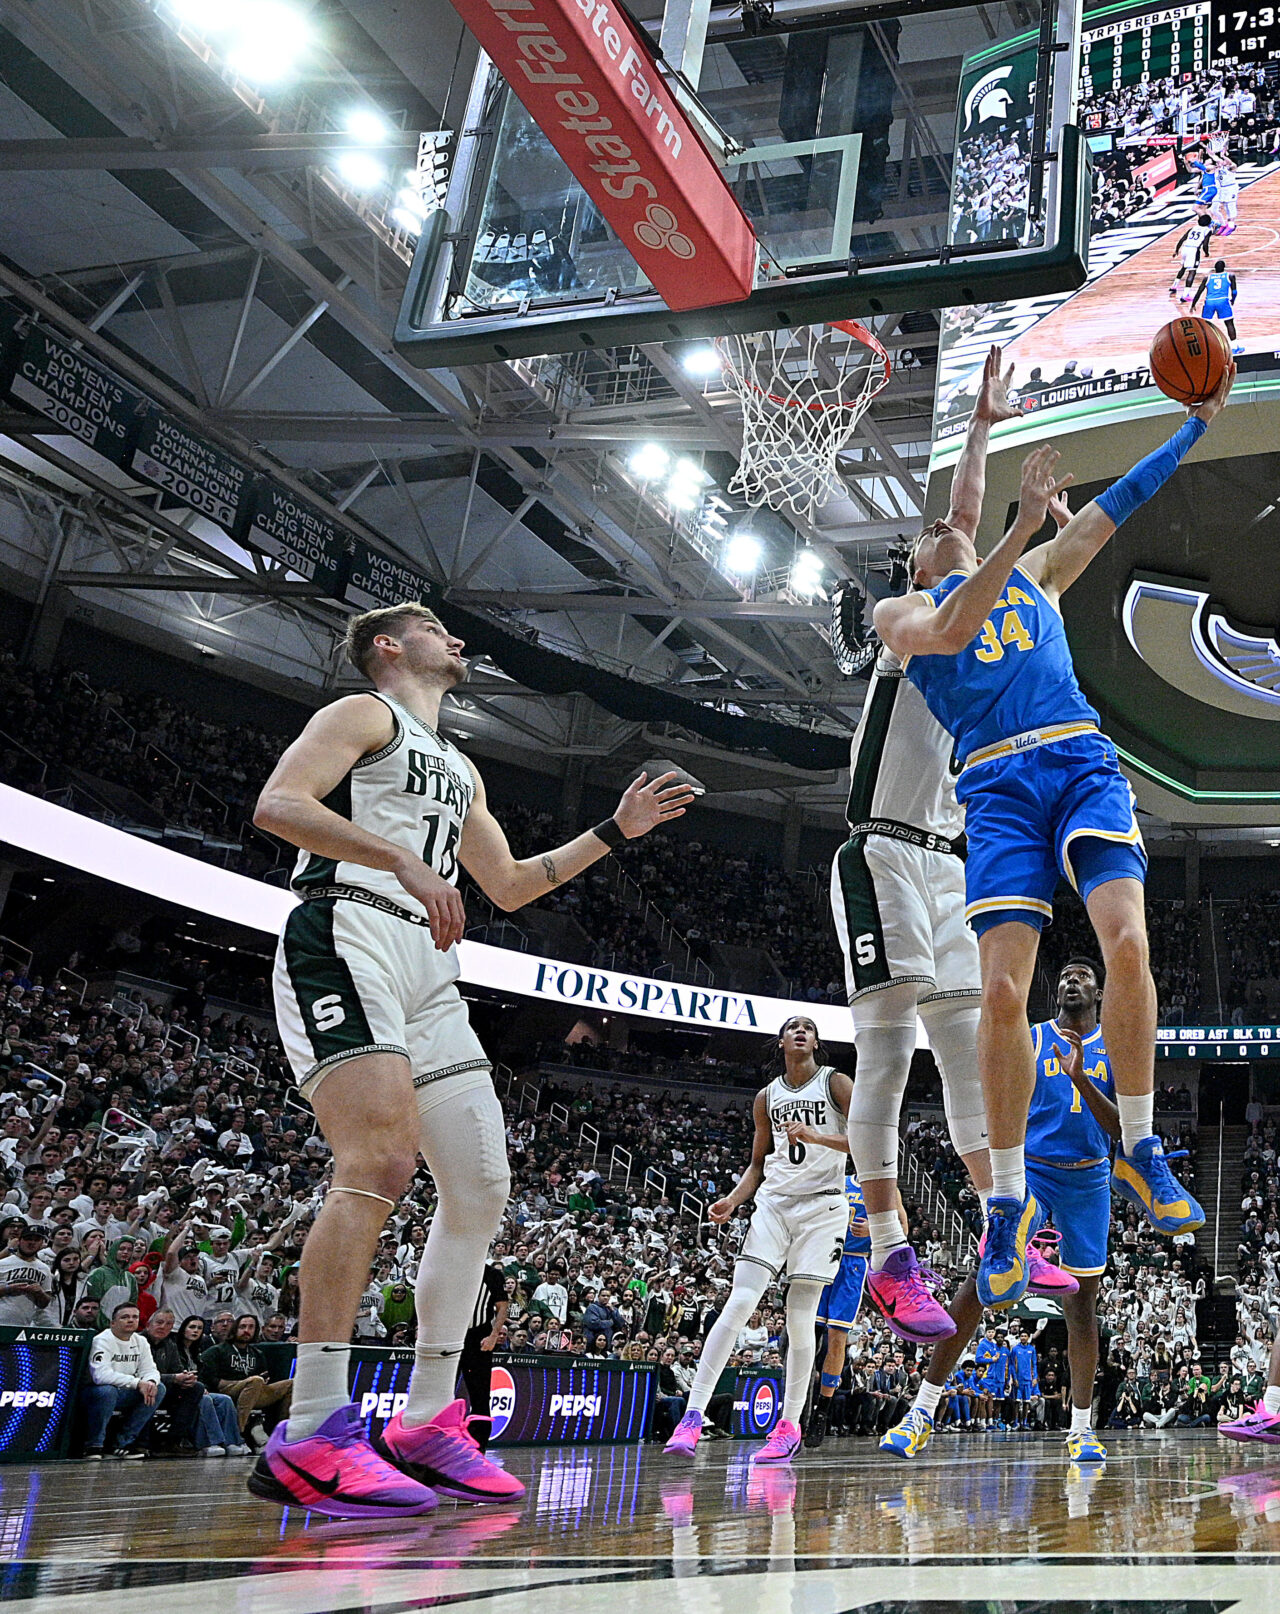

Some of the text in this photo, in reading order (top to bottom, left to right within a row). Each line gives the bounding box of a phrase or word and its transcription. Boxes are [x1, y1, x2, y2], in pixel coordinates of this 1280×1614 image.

[1107, 5, 1203, 34] PTS REB AST F
[1084, 31, 1179, 65] 1 1
[1241, 36, 1267, 51] 1ST
[1079, 60, 1148, 88] 15 1
[1113, 57, 1121, 67] 3
[1211, 56, 1238, 67] POSS
[45, 339, 123, 404] WOMEN'S
[47, 361, 112, 413] BIG TEN
[23, 362, 126, 439] CHAMPIONS
[1041, 380, 1112, 406] LOUISVILLE
[43, 398, 94, 443] 2005
[158, 420, 216, 464] WOMEN'S
[150, 444, 239, 506] CHAMPIONS
[155, 431, 241, 492] TOURNAMENT
[161, 471, 216, 513] 2005
[272, 492, 334, 541] WOMEN'S
[275, 511, 326, 550] BIG TEN
[256, 513, 338, 571] CHAMPIONS
[277, 545, 311, 576] 2011
[367, 552, 431, 593] WOMEN'S
[370, 568, 422, 602] BIG TEN
[974, 610, 1035, 663] 34
[1014, 738, 1038, 750] Ucla
[855, 932, 876, 966] S
[533, 962, 759, 1027] FOR SPARTA
[312, 994, 347, 1031] S
[1188, 1045, 1196, 1056] 0
[1240, 1045, 1247, 1056] 0
[1261, 1044, 1268, 1055] 0
[1208, 1029, 1229, 1039] AST
[1233, 1029, 1253, 1039] BLK
[1258, 1028, 1271, 1039] TO
[30, 1333, 80, 1342] ACRISURE
[0, 1391, 56, 1407] PEPSI
[548, 1394, 601, 1417] PEPSI
[756, 1401, 771, 1410] PEPSI
